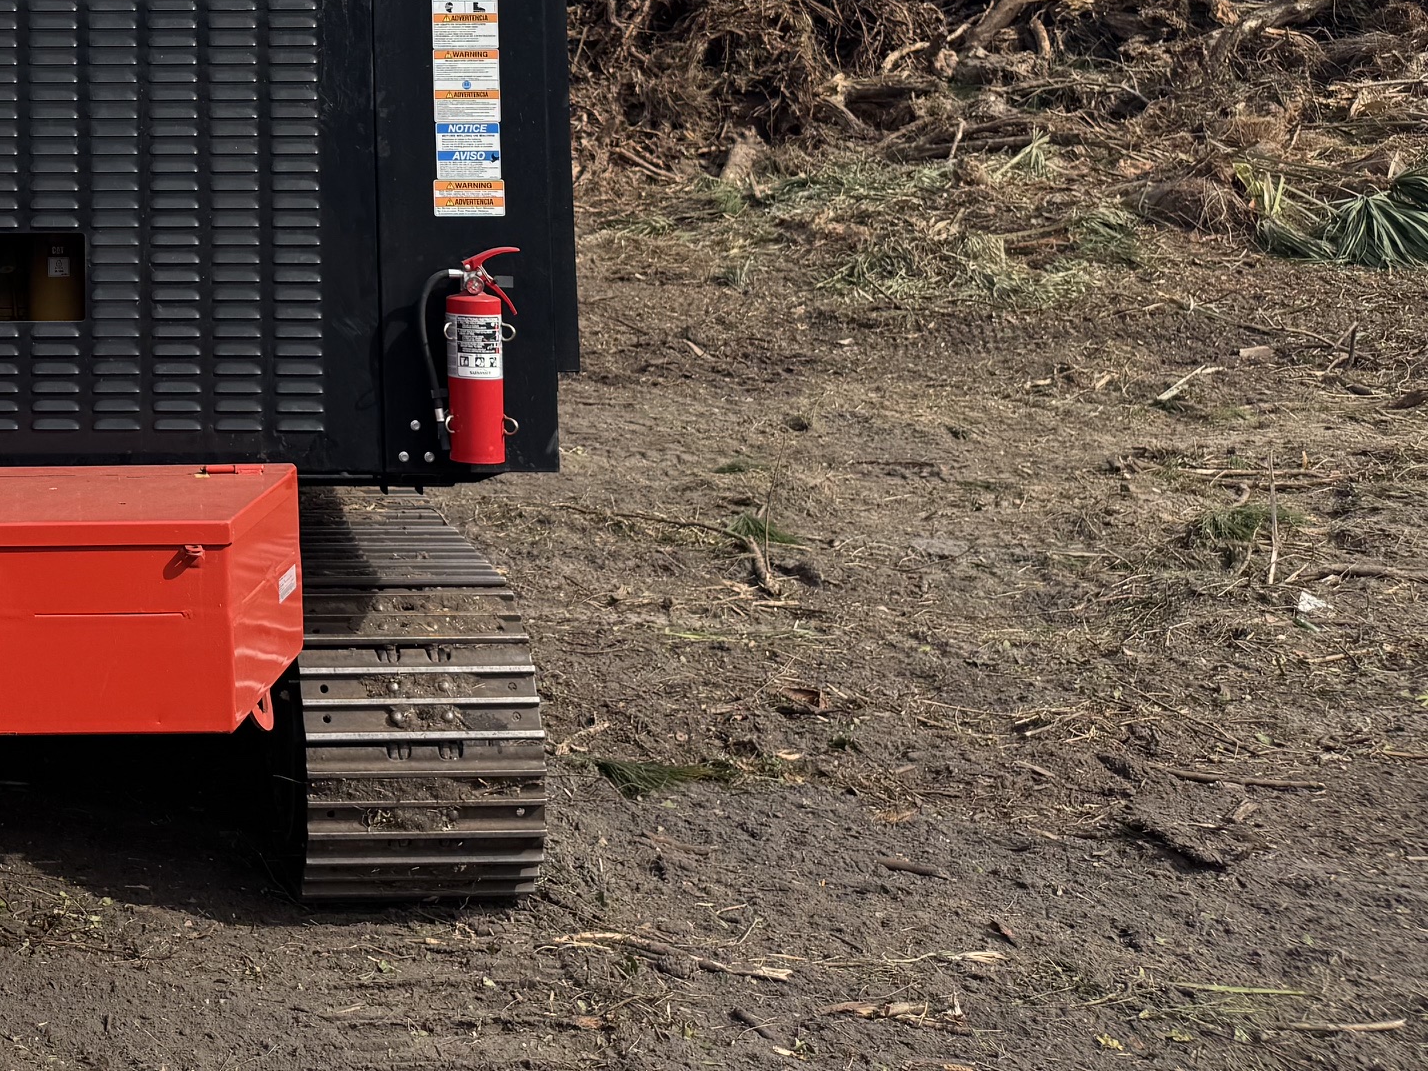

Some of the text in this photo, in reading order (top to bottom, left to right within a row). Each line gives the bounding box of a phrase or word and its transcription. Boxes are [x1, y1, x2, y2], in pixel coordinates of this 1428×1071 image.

[451, 14, 489, 22] ADVERTENCIA
[448, 124, 488, 133] NOTICE
[452, 151, 486, 160] AVISO
[455, 198, 494, 206] ADVERTENCIA
[52, 246, 64, 254] CAT
